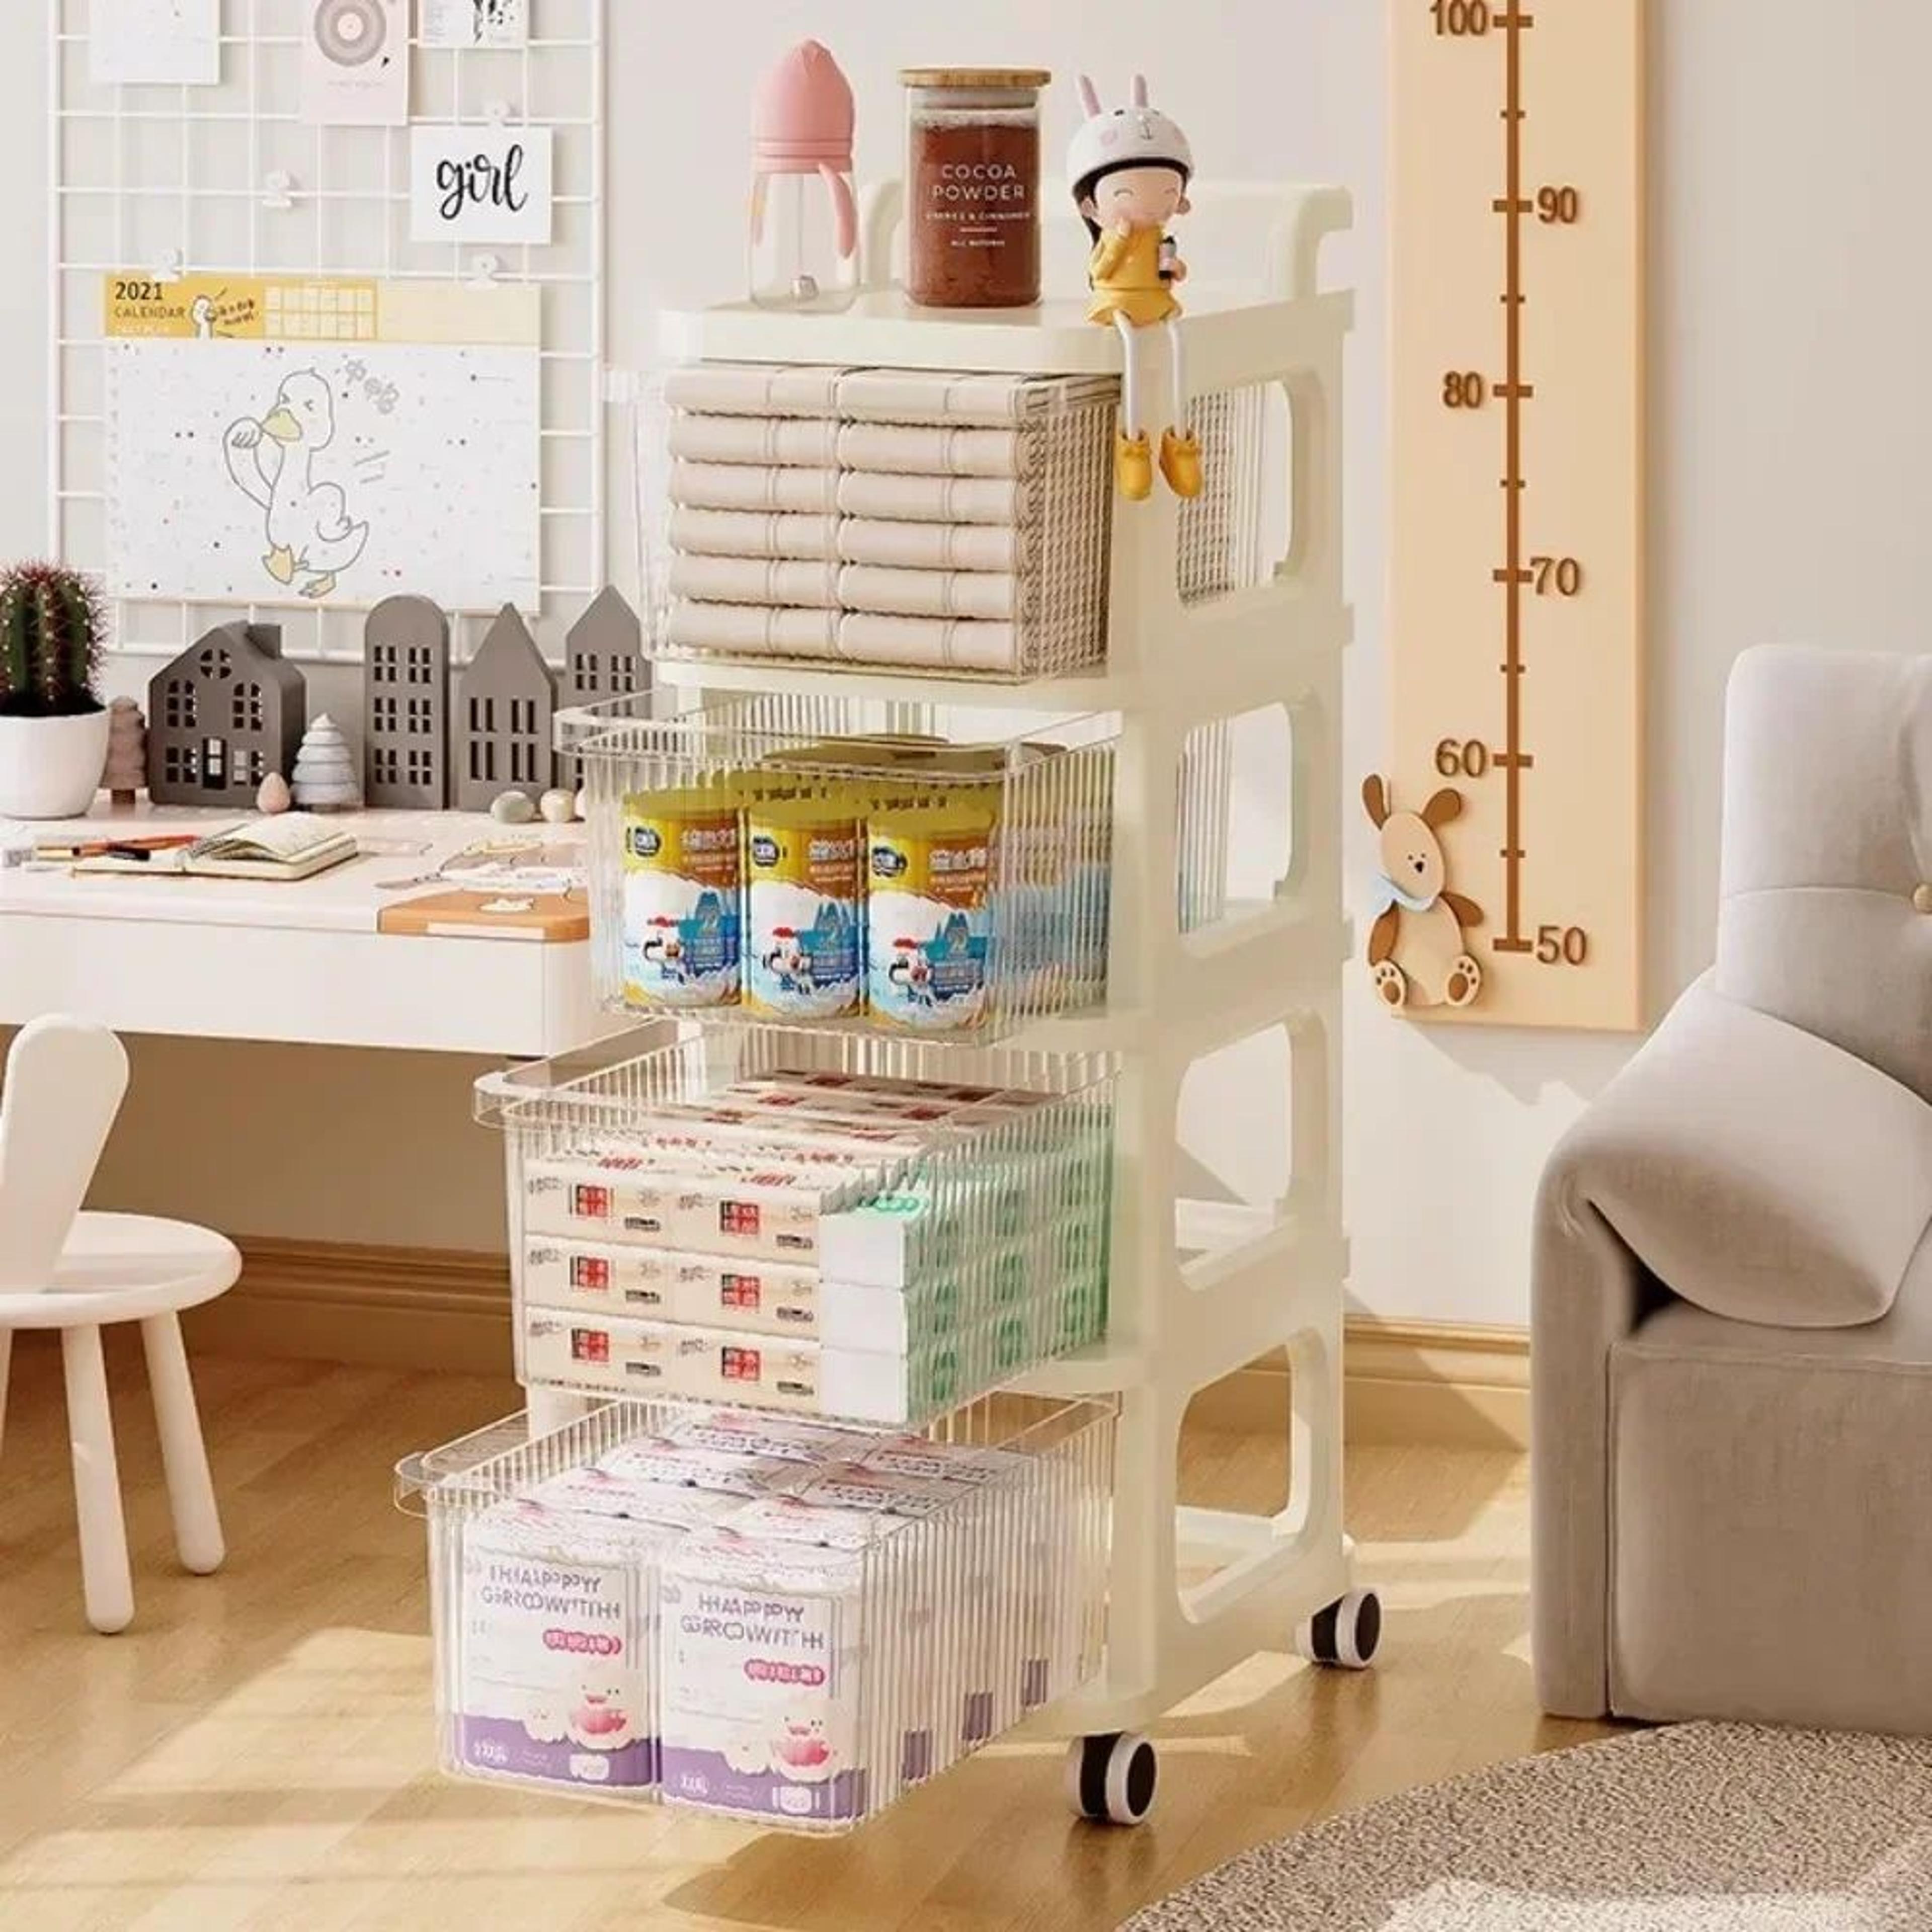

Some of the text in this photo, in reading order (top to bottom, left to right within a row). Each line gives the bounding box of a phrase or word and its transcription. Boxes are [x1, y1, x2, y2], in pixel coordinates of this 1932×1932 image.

[1430, 0, 1487, 35] 100
[437, 143, 529, 220] girl
[941, 164, 1017, 179] COCOA
[933, 184, 1024, 200] POWDER
[1537, 186, 1578, 224] 90
[115, 281, 164, 300] 2021
[114, 305, 187, 319] CALENDAR
[1442, 371, 1483, 409] 80
[1530, 556, 1580, 597] 70
[1435, 739, 1486, 778] 60
[1537, 926, 1587, 965] 50
